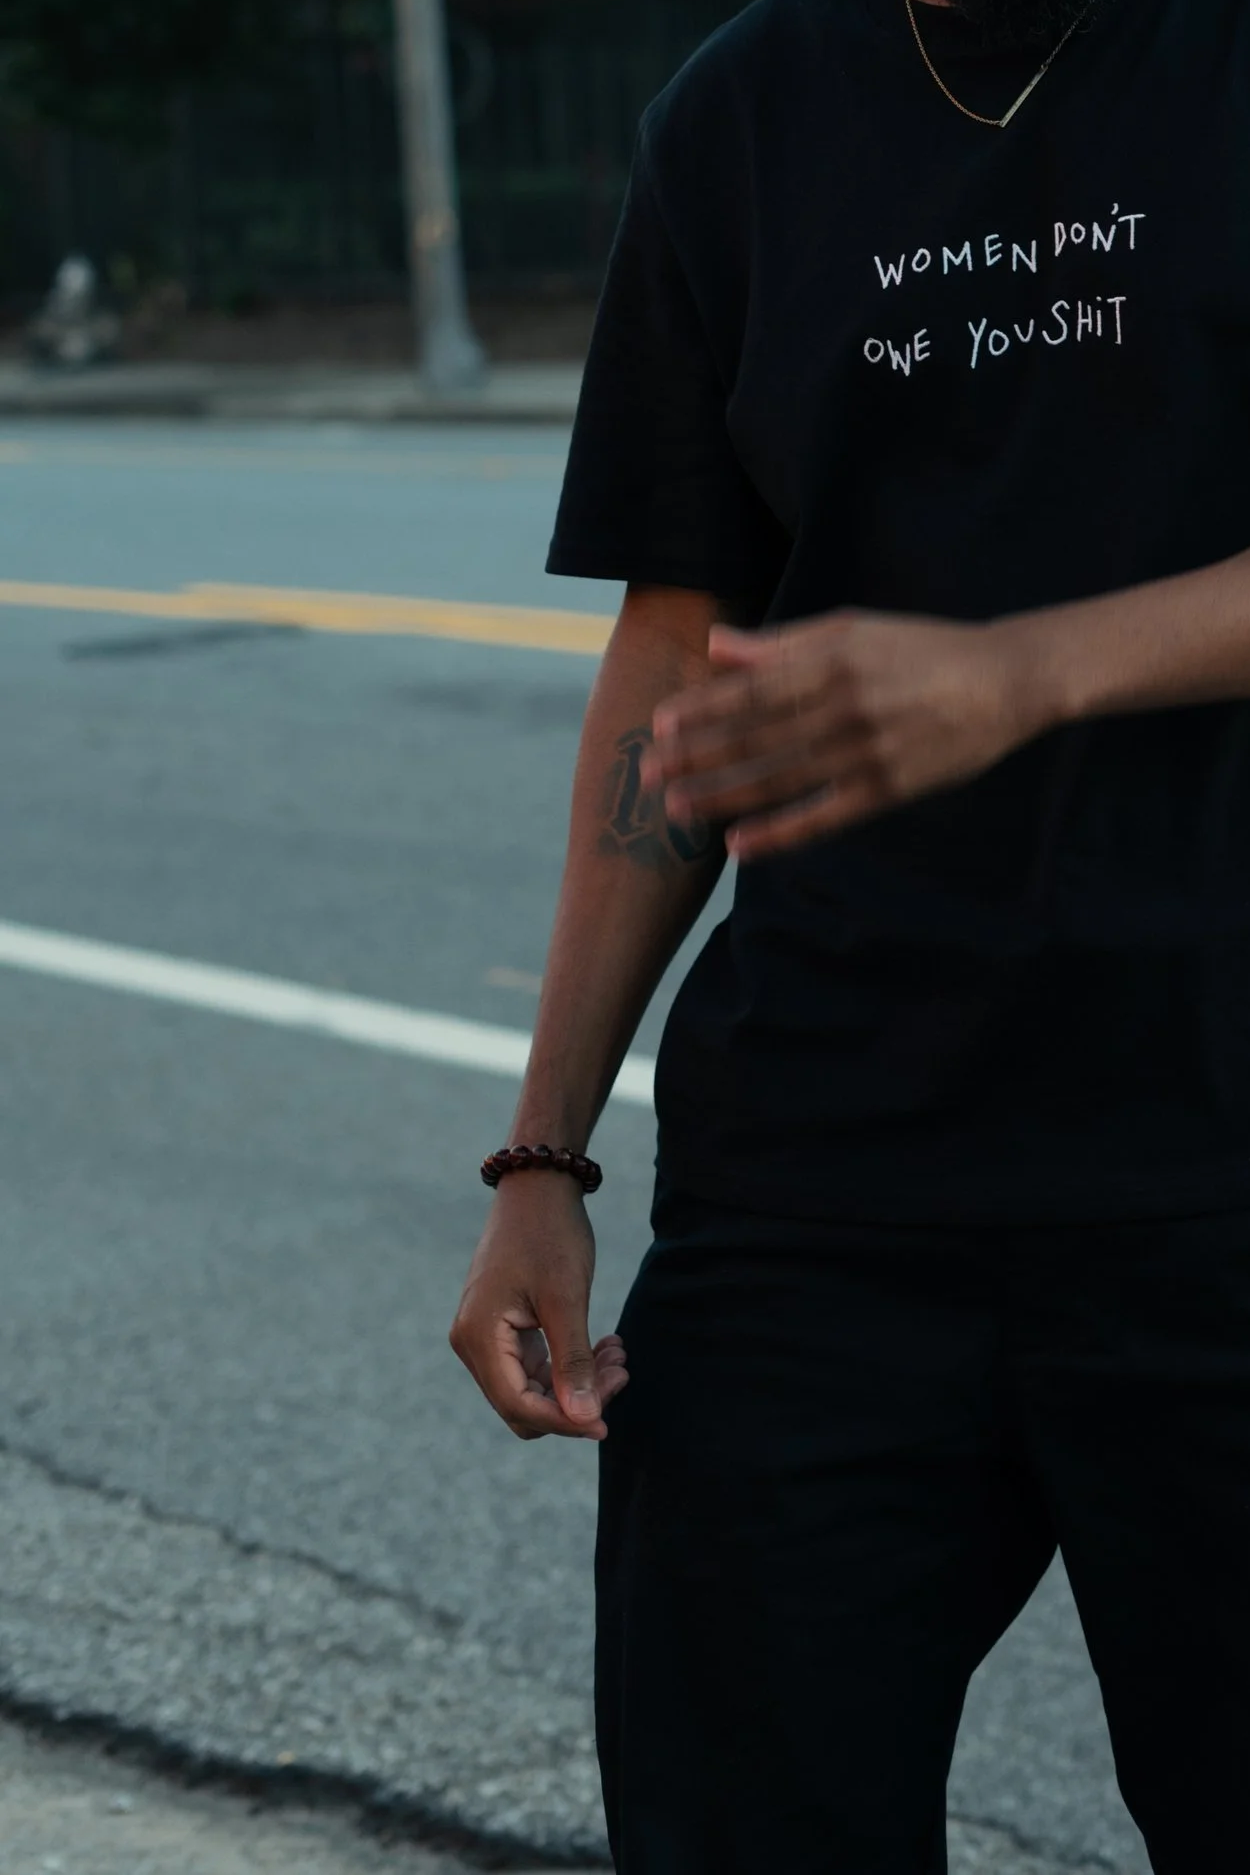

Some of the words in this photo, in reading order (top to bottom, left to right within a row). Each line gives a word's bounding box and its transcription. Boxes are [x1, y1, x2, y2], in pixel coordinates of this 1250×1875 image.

[873, 233, 1037, 290] WOMEN
[1053, 202, 1147, 257] DON'T
[863, 328, 931, 377] OWE
[967, 317, 1035, 370] YOU
